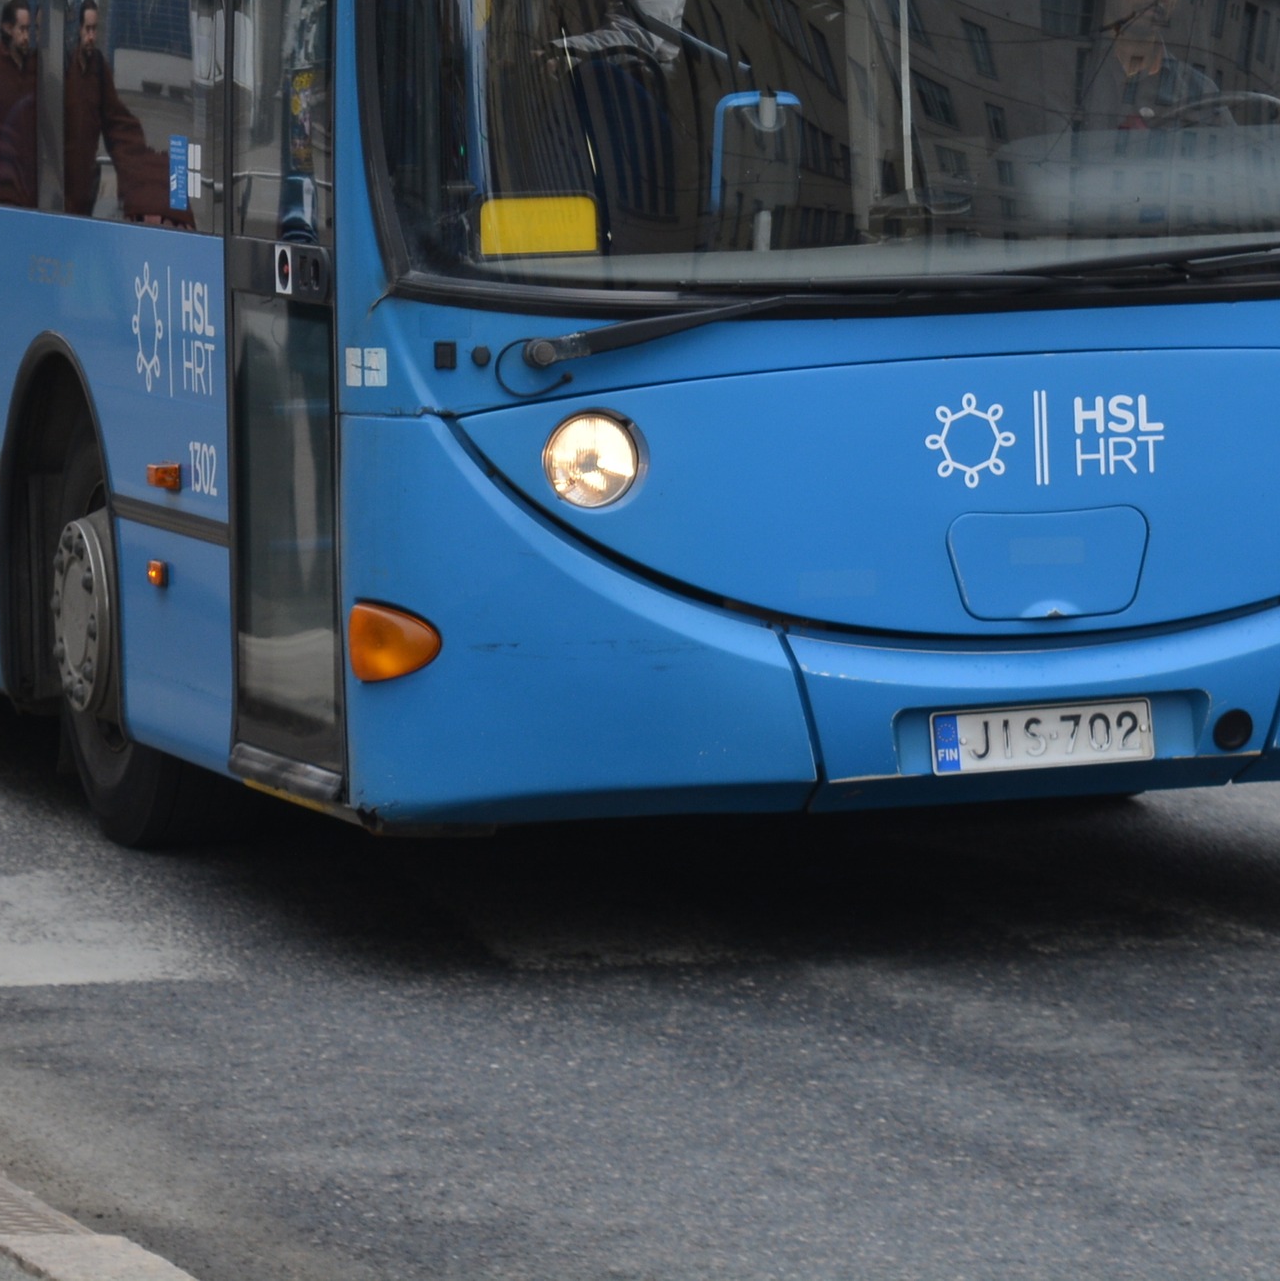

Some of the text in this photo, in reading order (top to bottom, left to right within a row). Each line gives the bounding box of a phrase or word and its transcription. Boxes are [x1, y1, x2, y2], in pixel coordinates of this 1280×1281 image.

[181, 279, 214, 337] HSL
[182, 338, 215, 396] HRT
[1074, 394, 1164, 434] HSL
[189, 441, 218, 496] 1302
[1076, 435, 1164, 476] HRT
[937, 748, 959, 761] FIN
